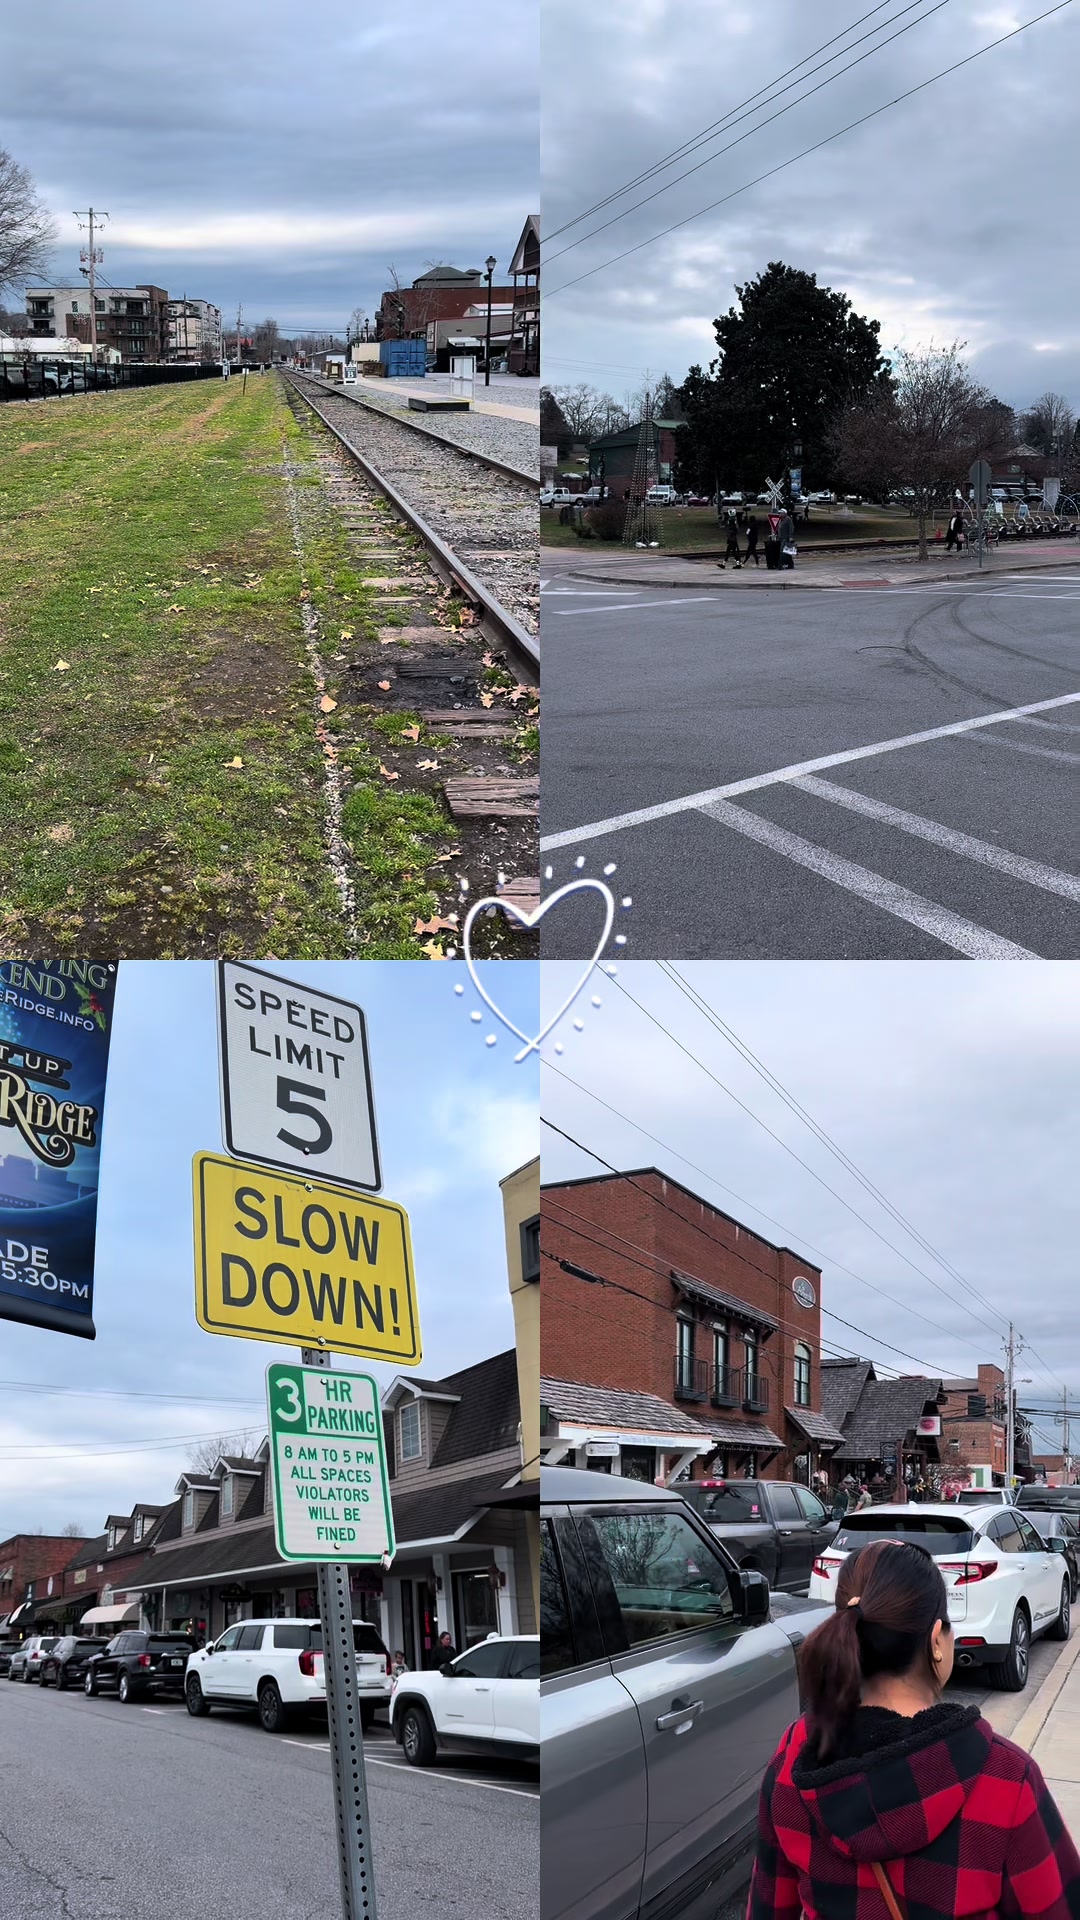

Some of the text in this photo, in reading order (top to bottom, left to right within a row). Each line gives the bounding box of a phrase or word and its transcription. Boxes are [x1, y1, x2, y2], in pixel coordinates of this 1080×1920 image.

[233, 982, 355, 1043] SPEED
[25, 1052, 60, 1074] UP
[250, 1025, 345, 1079] LIMIT
[276, 1075, 333, 1155] 5
[234, 1186, 380, 1266] SLOW
[0, 1239, 49, 1269] DE
[1, 1260, 89, 1299] 5:30PM
[221, 1252, 400, 1336] DOWN!
[275, 1377, 353, 1422] 3 HR
[307, 1405, 375, 1434] PARKING
[284, 1445, 374, 1465] 8 AM TO 5 PM
[291, 1465, 372, 1483] ALL SPACES
[296, 1485, 370, 1502] VIOLATORS
[308, 1506, 361, 1522] WILL BE
[317, 1526, 356, 1541] FINED
